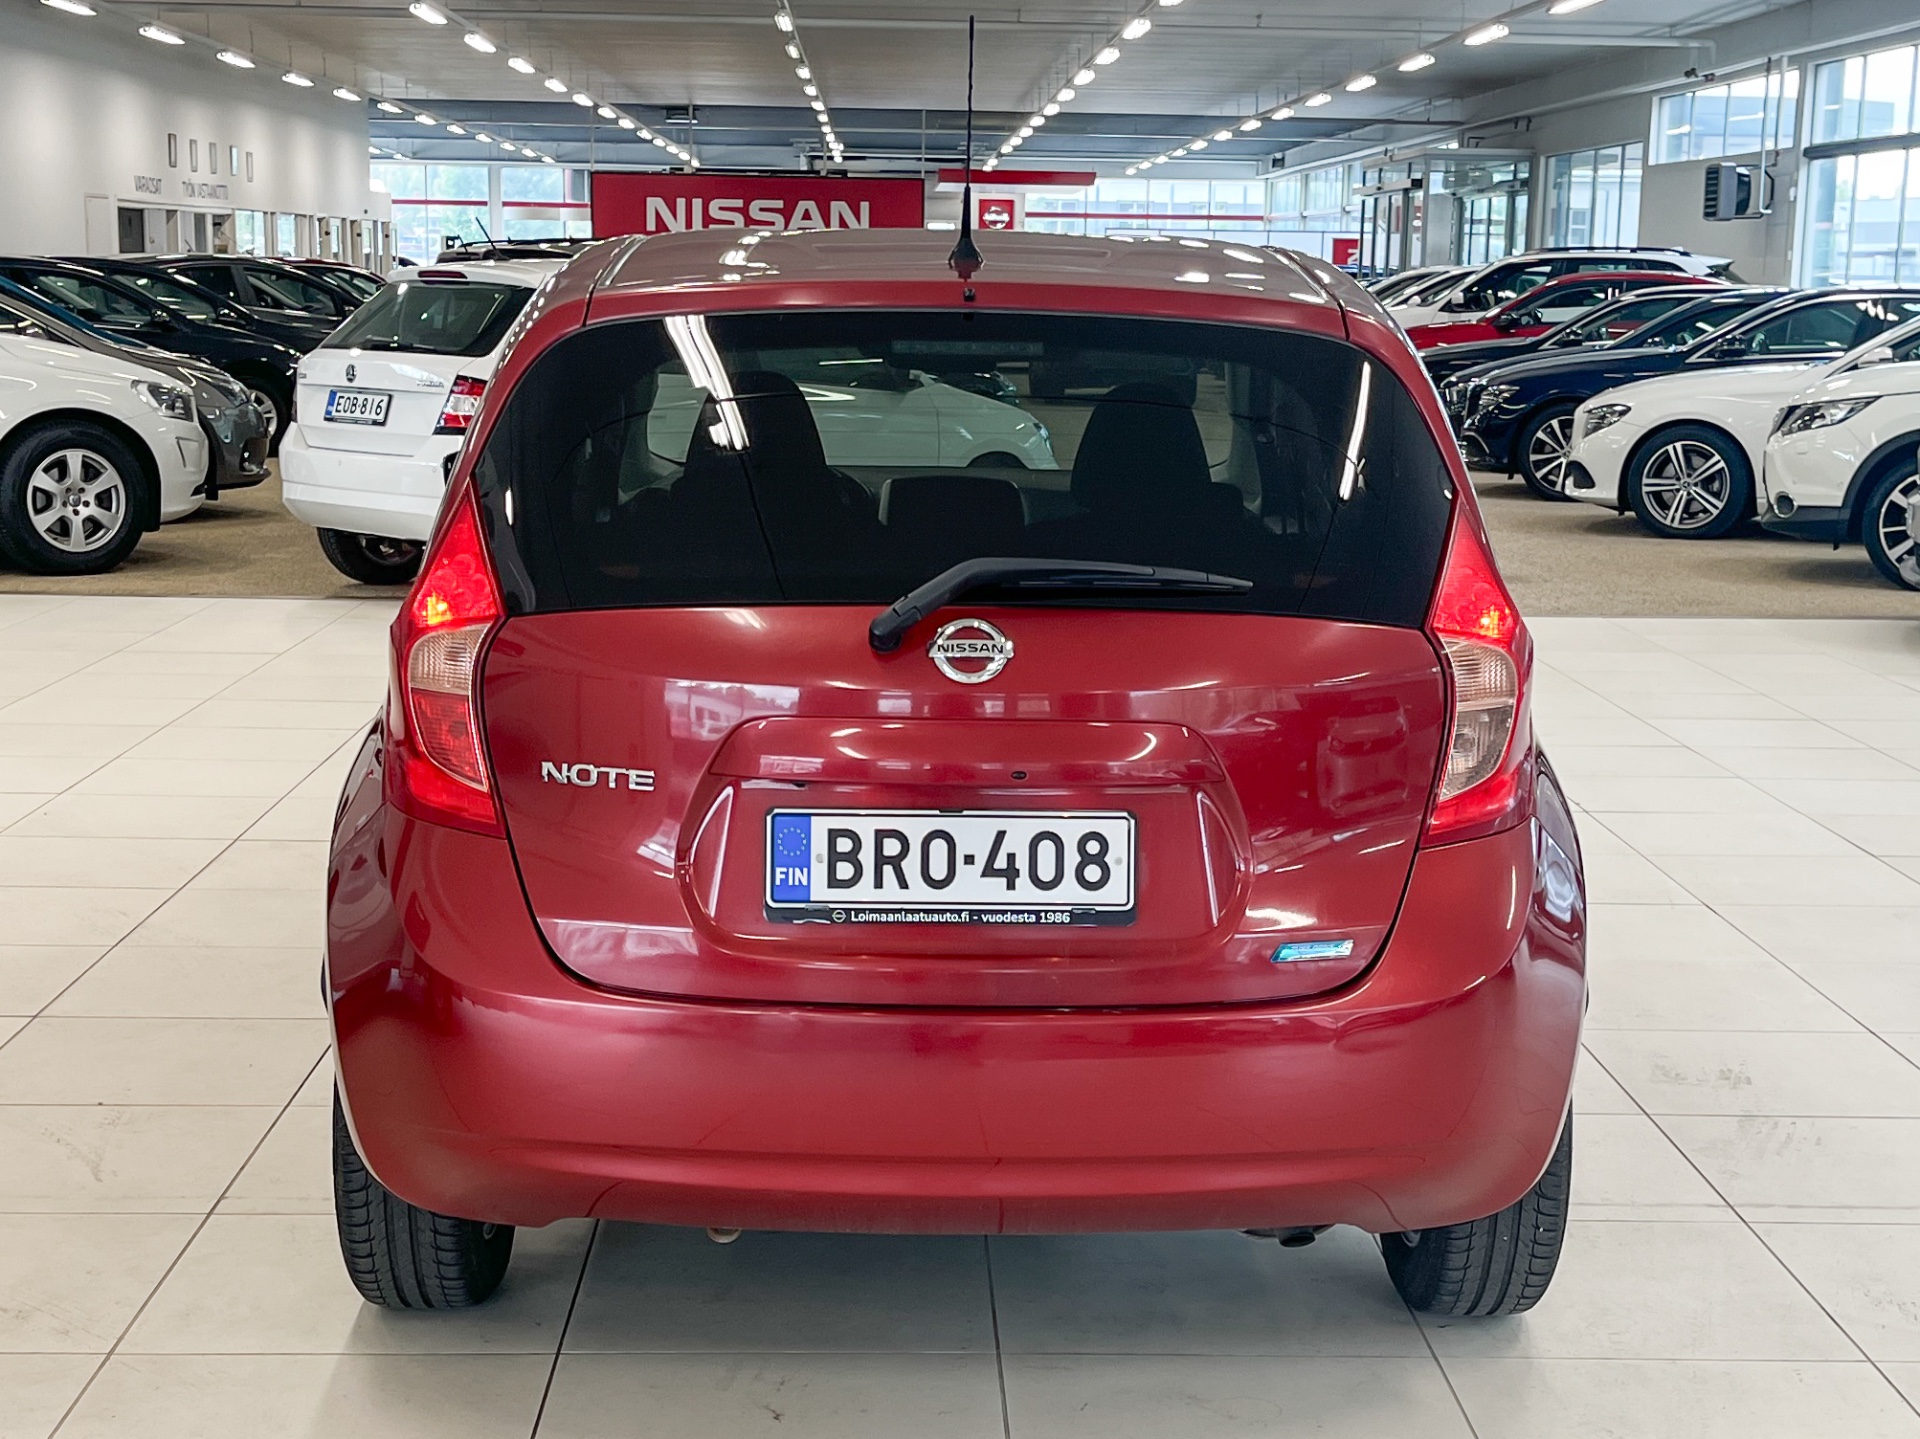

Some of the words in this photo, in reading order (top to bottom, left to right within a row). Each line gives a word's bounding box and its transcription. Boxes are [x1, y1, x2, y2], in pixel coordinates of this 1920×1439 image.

[646, 196, 869, 232] NISSAN
[937, 643, 1004, 654] NISSAN
[541, 761, 655, 791] NOTE
[775, 867, 808, 886] FIN
[850, 911, 970, 923] Loimaanlaatuauto.fi
[981, 912, 1036, 923] vuodesta
[1039, 912, 1071, 923] 1986
